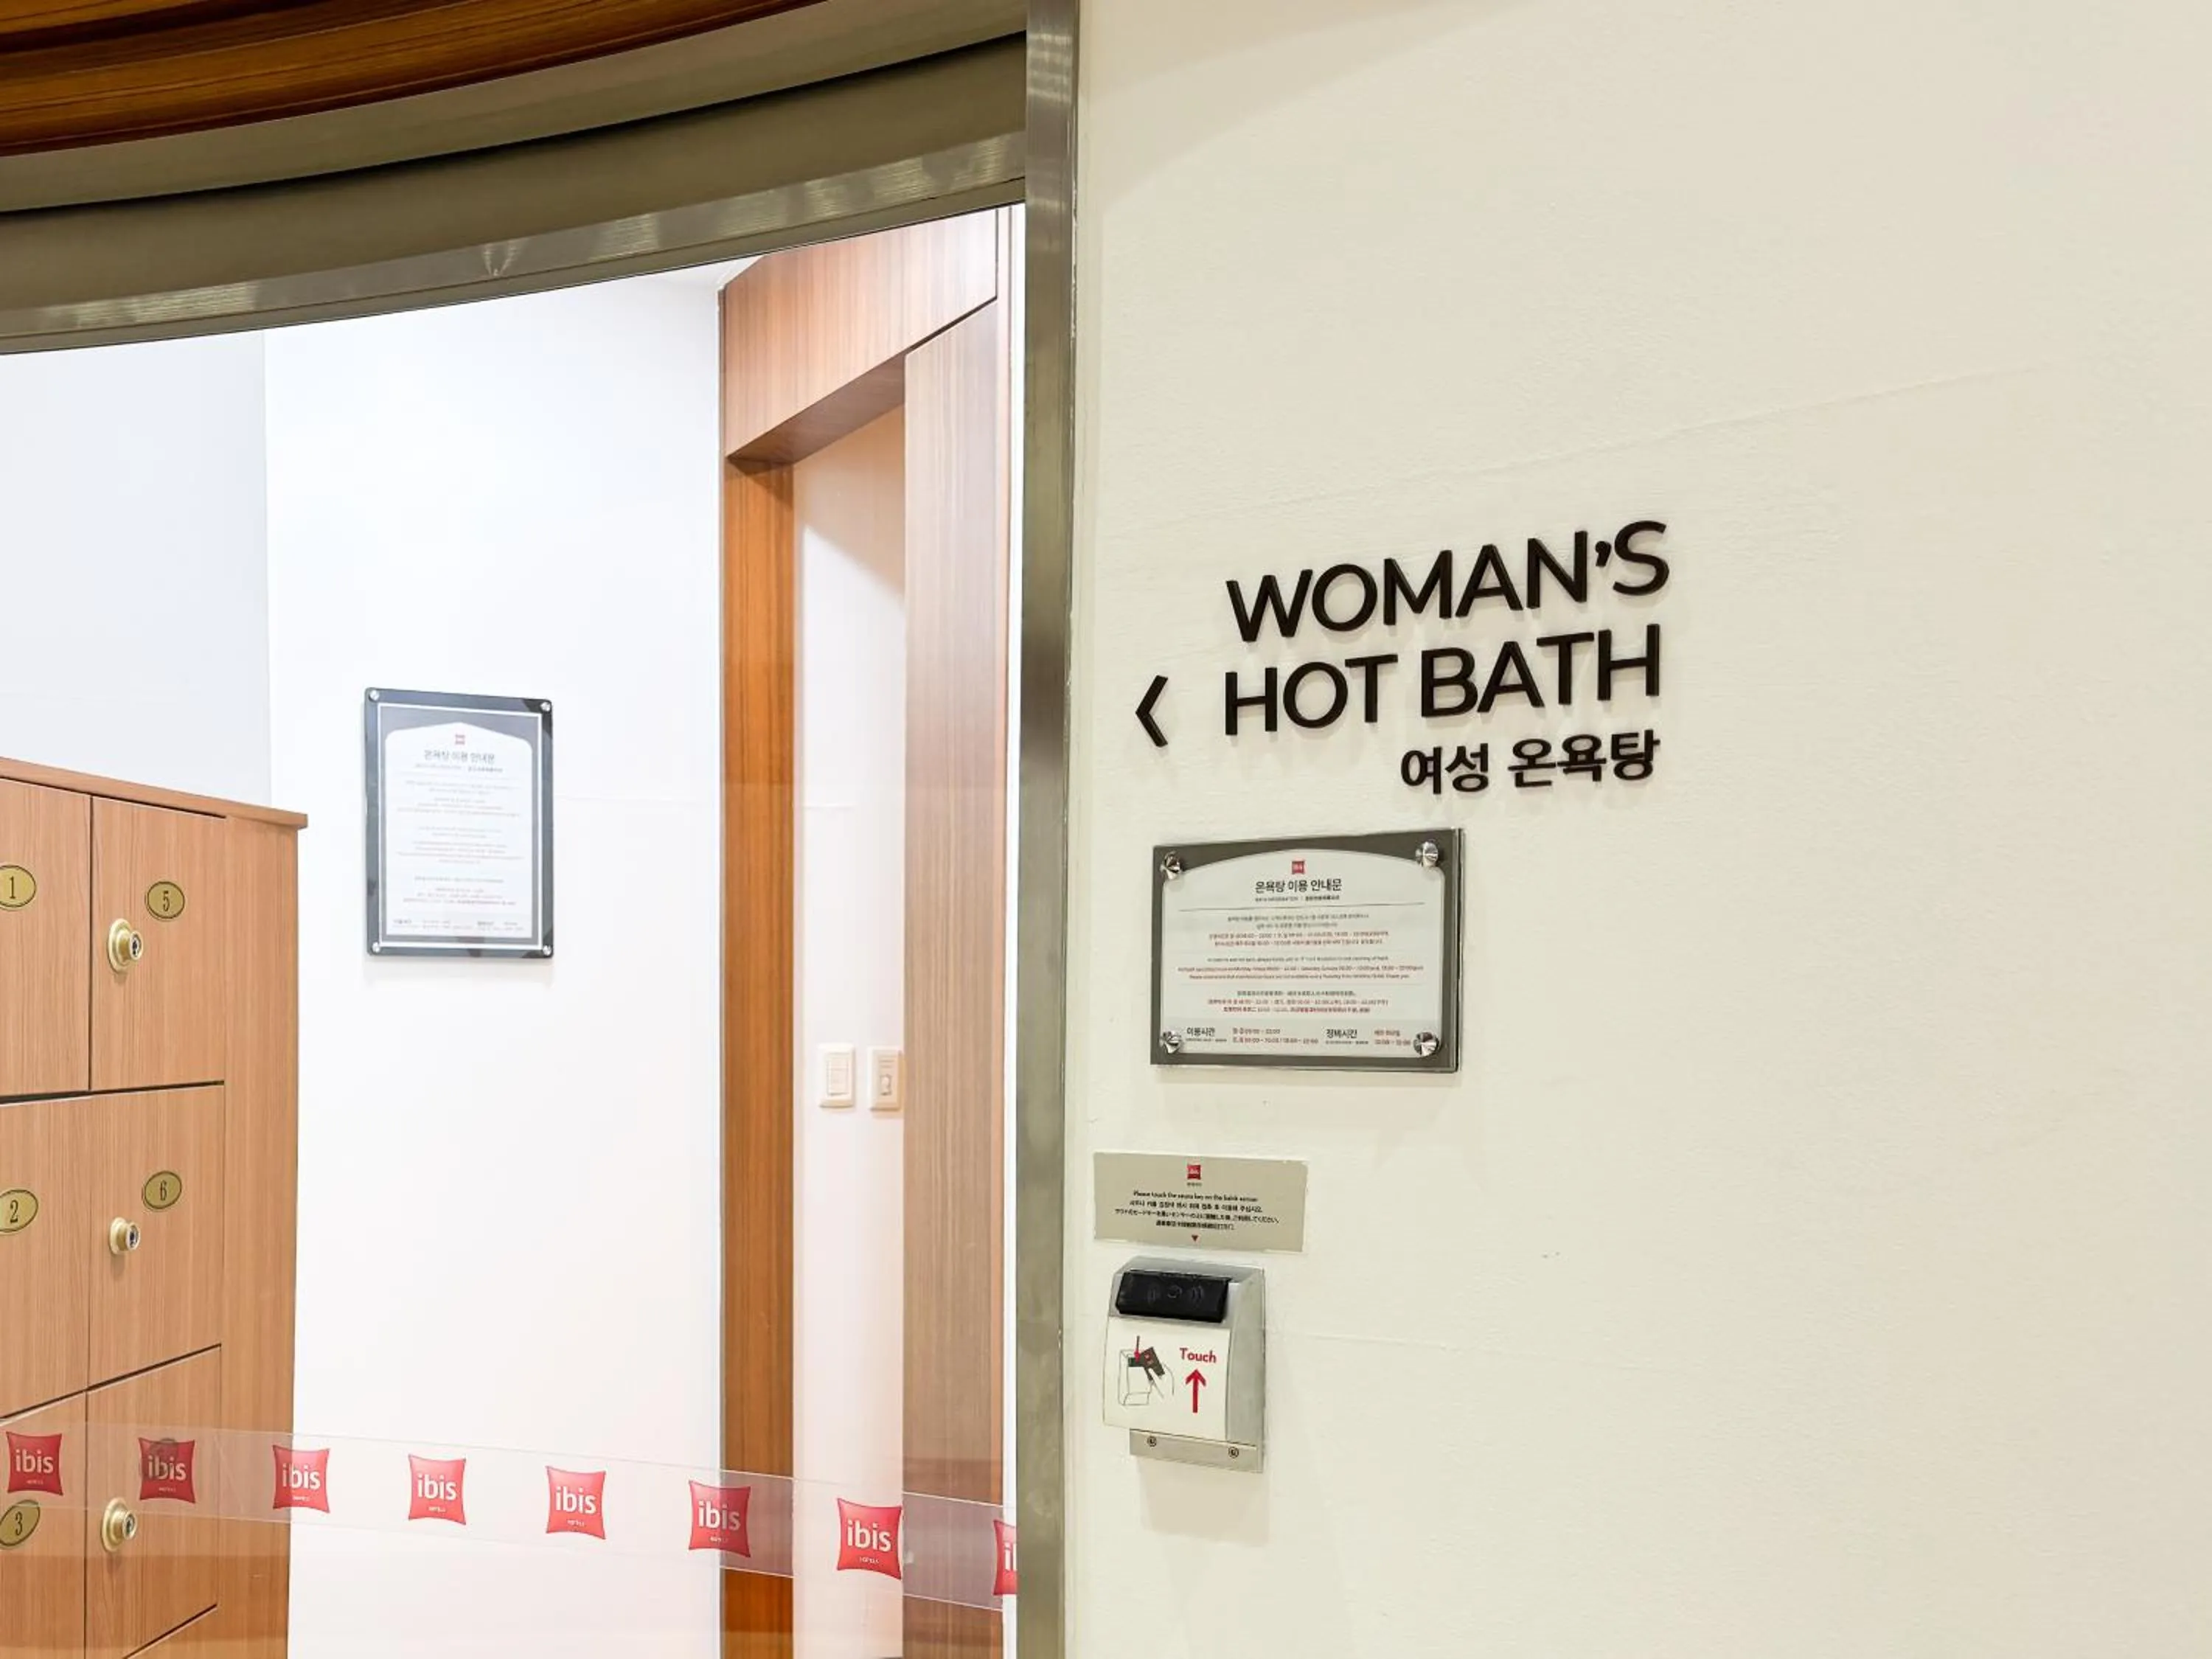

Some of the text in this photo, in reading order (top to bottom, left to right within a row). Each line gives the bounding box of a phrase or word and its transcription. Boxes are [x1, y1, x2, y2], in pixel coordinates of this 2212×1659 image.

[1225, 521, 1669, 643] WOMAN'S
[1225, 624, 1660, 736] HOT BATH
[1400, 728, 1660, 794] 여성 온욕탕
[10, 876, 15, 899] 1
[1255, 878, 1342, 894] 온욕탕 이용 안내문
[163, 890, 170, 912] 5
[160, 1180, 167, 1201] 6
[10, 1200, 18, 1223] 2
[1180, 1347, 1217, 1363] Touch
[15, 1449, 54, 1474] ibis
[148, 1455, 187, 1481] ibis
[282, 1462, 321, 1490] ibis
[417, 1473, 456, 1501] ibis
[556, 1486, 597, 1514] ibis
[15, 1512, 23, 1536] 3
[698, 1500, 741, 1531] ibis
[847, 1519, 891, 1552] ibis
